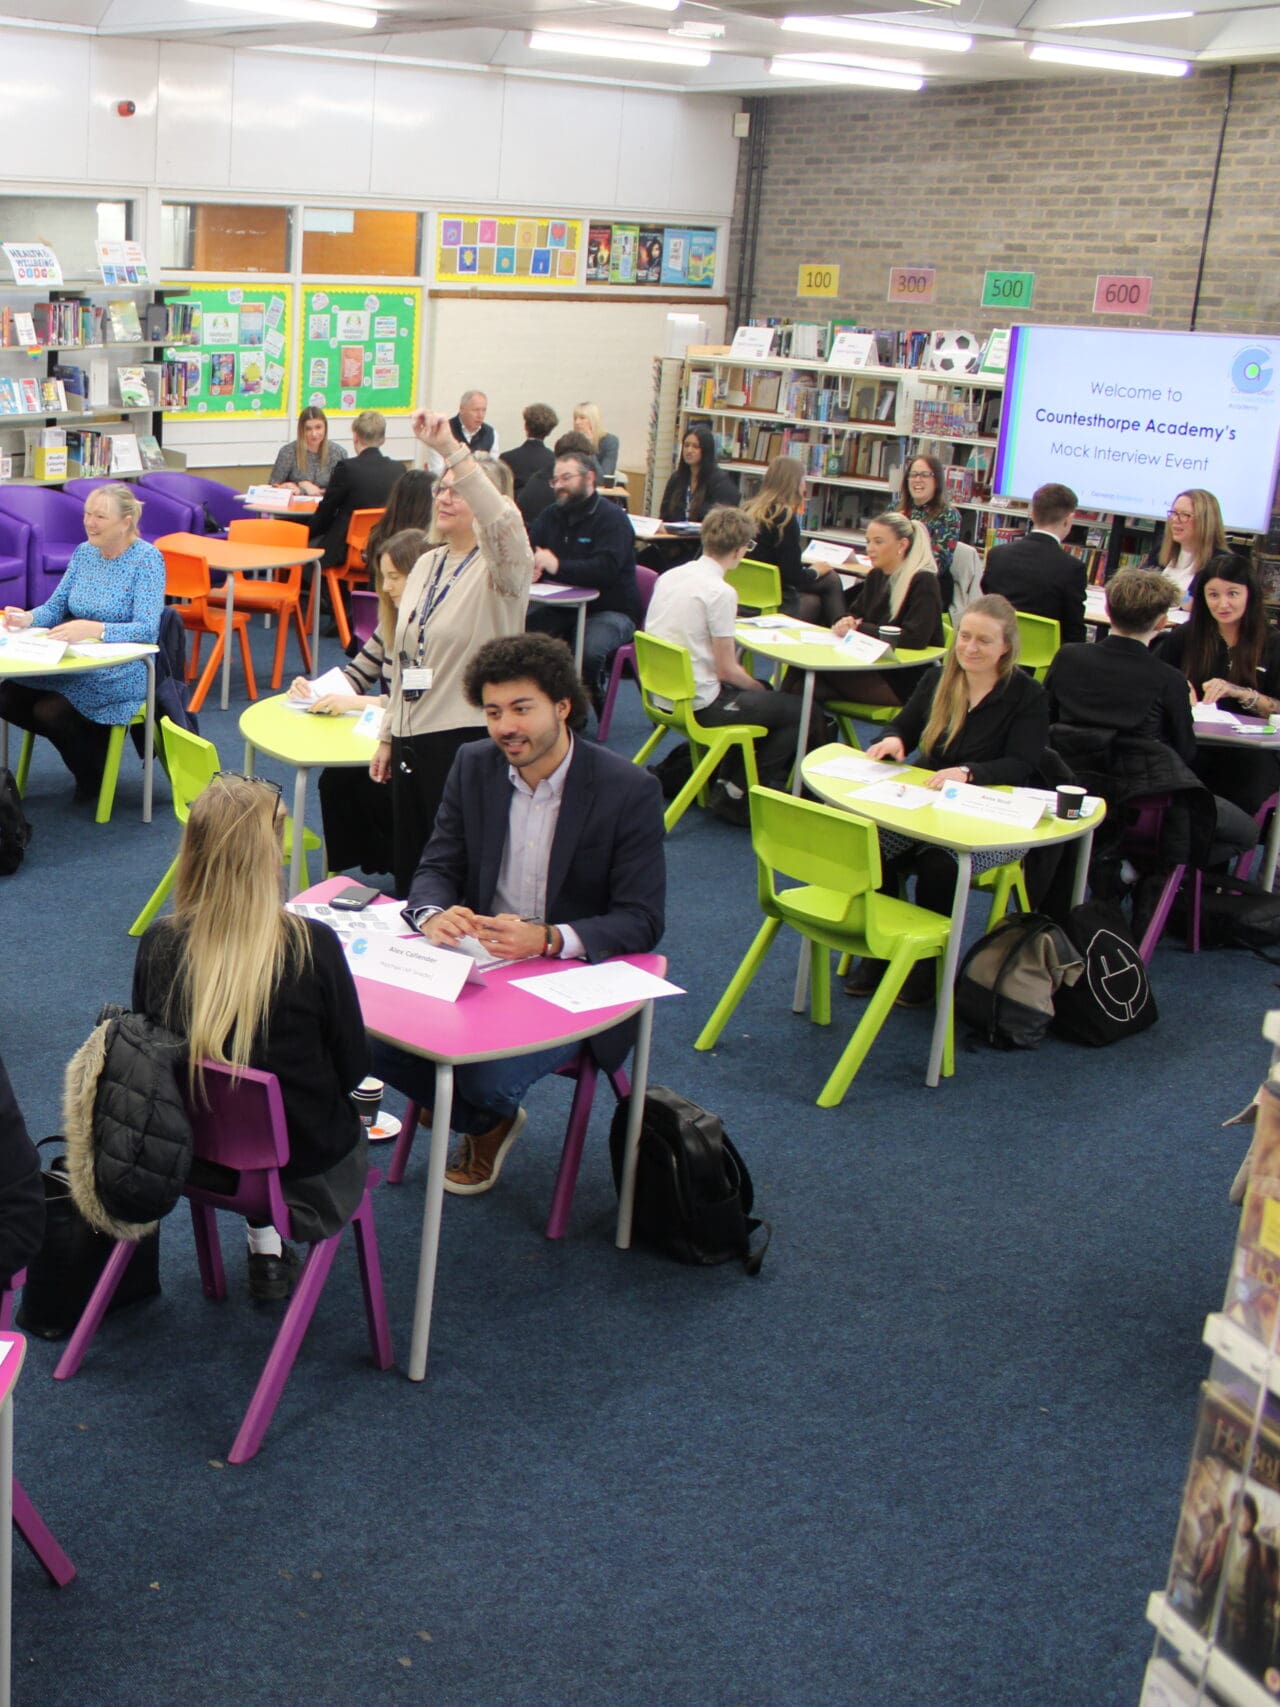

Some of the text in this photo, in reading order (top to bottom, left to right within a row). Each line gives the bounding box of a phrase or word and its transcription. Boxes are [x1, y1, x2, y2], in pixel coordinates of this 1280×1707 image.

[9, 248, 42, 258] HEALTH
[15, 258, 54, 268] WELLBEING
[806, 271, 832, 289] 100
[897, 275, 927, 293] 300
[991, 278, 1024, 298] 500
[1104, 283, 1141, 304] 600
[1090, 381, 1183, 402] Welcome to
[1035, 408, 1237, 442] Countesthorpe Academy's
[1050, 441, 1210, 472] Mock Interview Event
[389, 946, 403, 955] Alex
